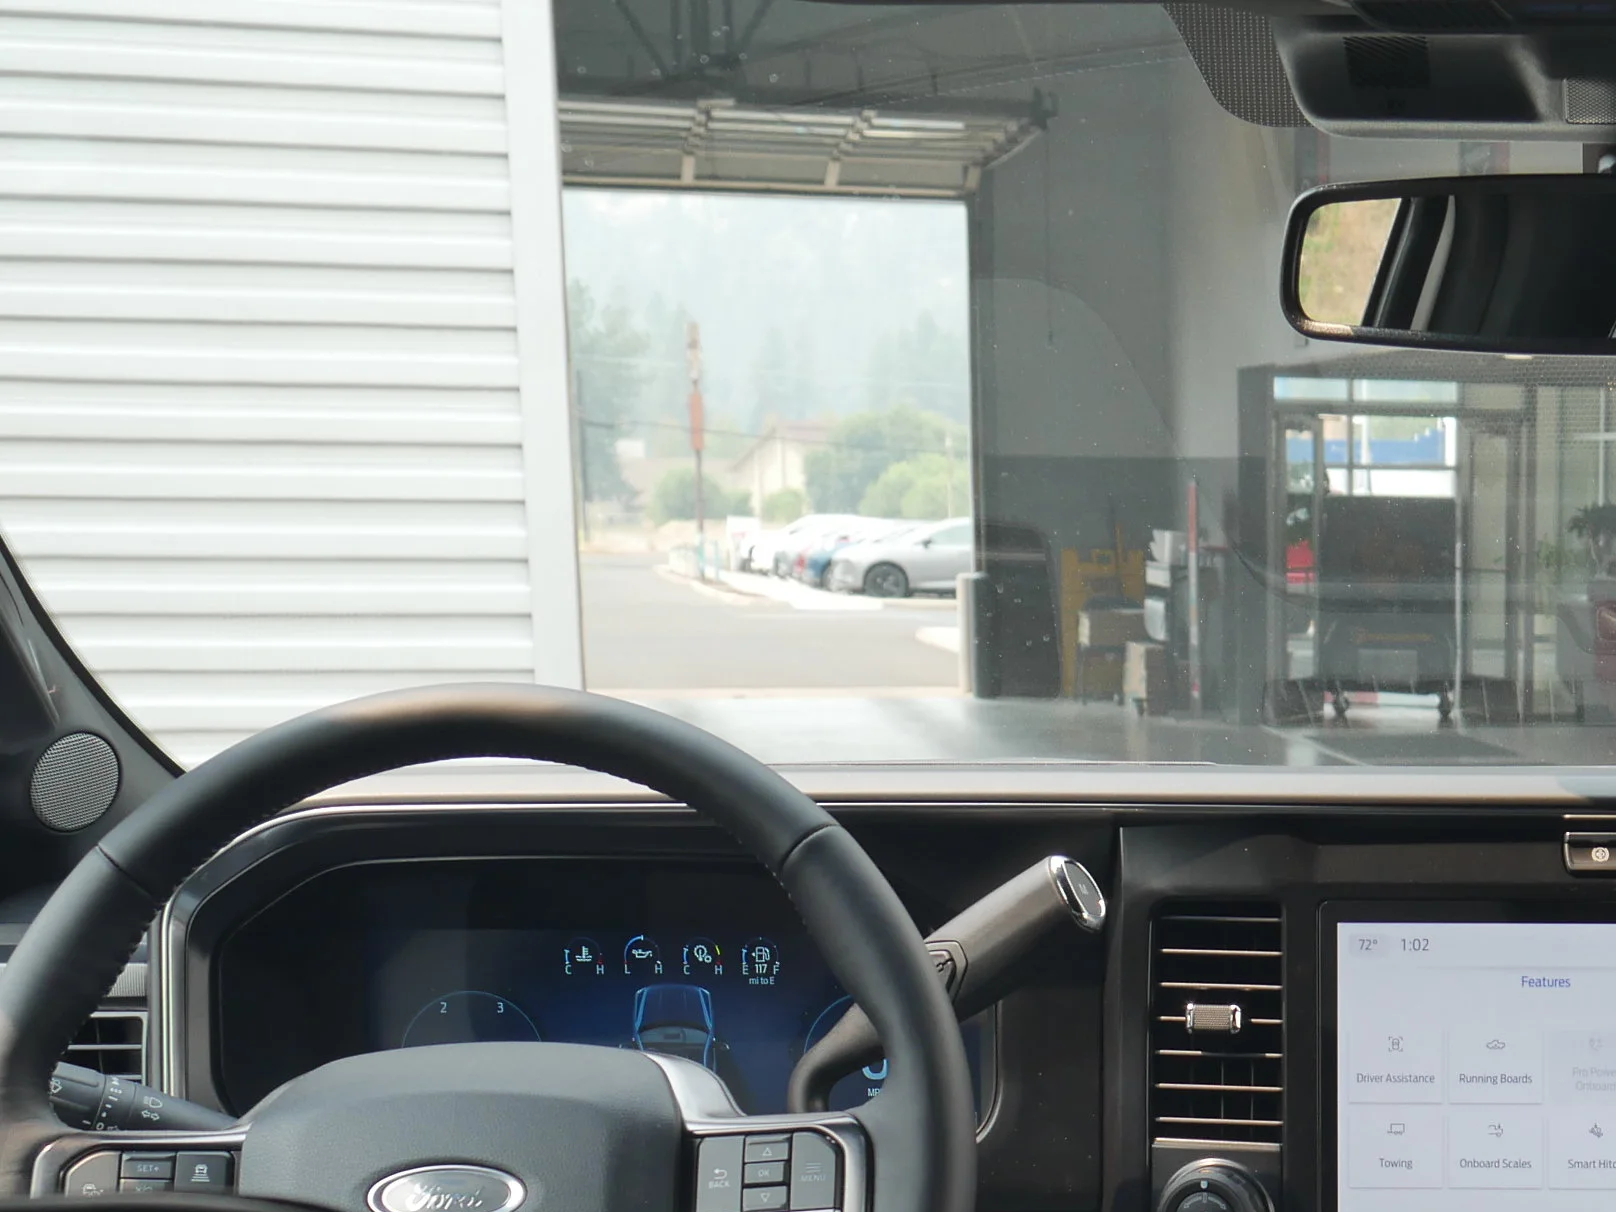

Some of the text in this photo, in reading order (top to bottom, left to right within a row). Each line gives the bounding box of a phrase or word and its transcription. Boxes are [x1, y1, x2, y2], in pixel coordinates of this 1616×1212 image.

[1401, 938, 1430, 952] 1:02
[596, 965, 604, 975] H
[624, 964, 631, 974] L
[655, 964, 663, 974] H
[715, 965, 723, 975] H
[742, 965, 749, 975] E
[755, 964, 768, 974] 117
[769, 976, 775, 985] E
[1521, 976, 1571, 988] Features
[440, 1002, 448, 1013] 2
[496, 1002, 504, 1013] 3
[1356, 1072, 1435, 1084] Driver Assistance
[1459, 1073, 1533, 1087] Running Boards
[1379, 1157, 1413, 1171] Towing
[1459, 1158, 1532, 1170] Onboard Scales
[1568, 1158, 1597, 1170] Smart
